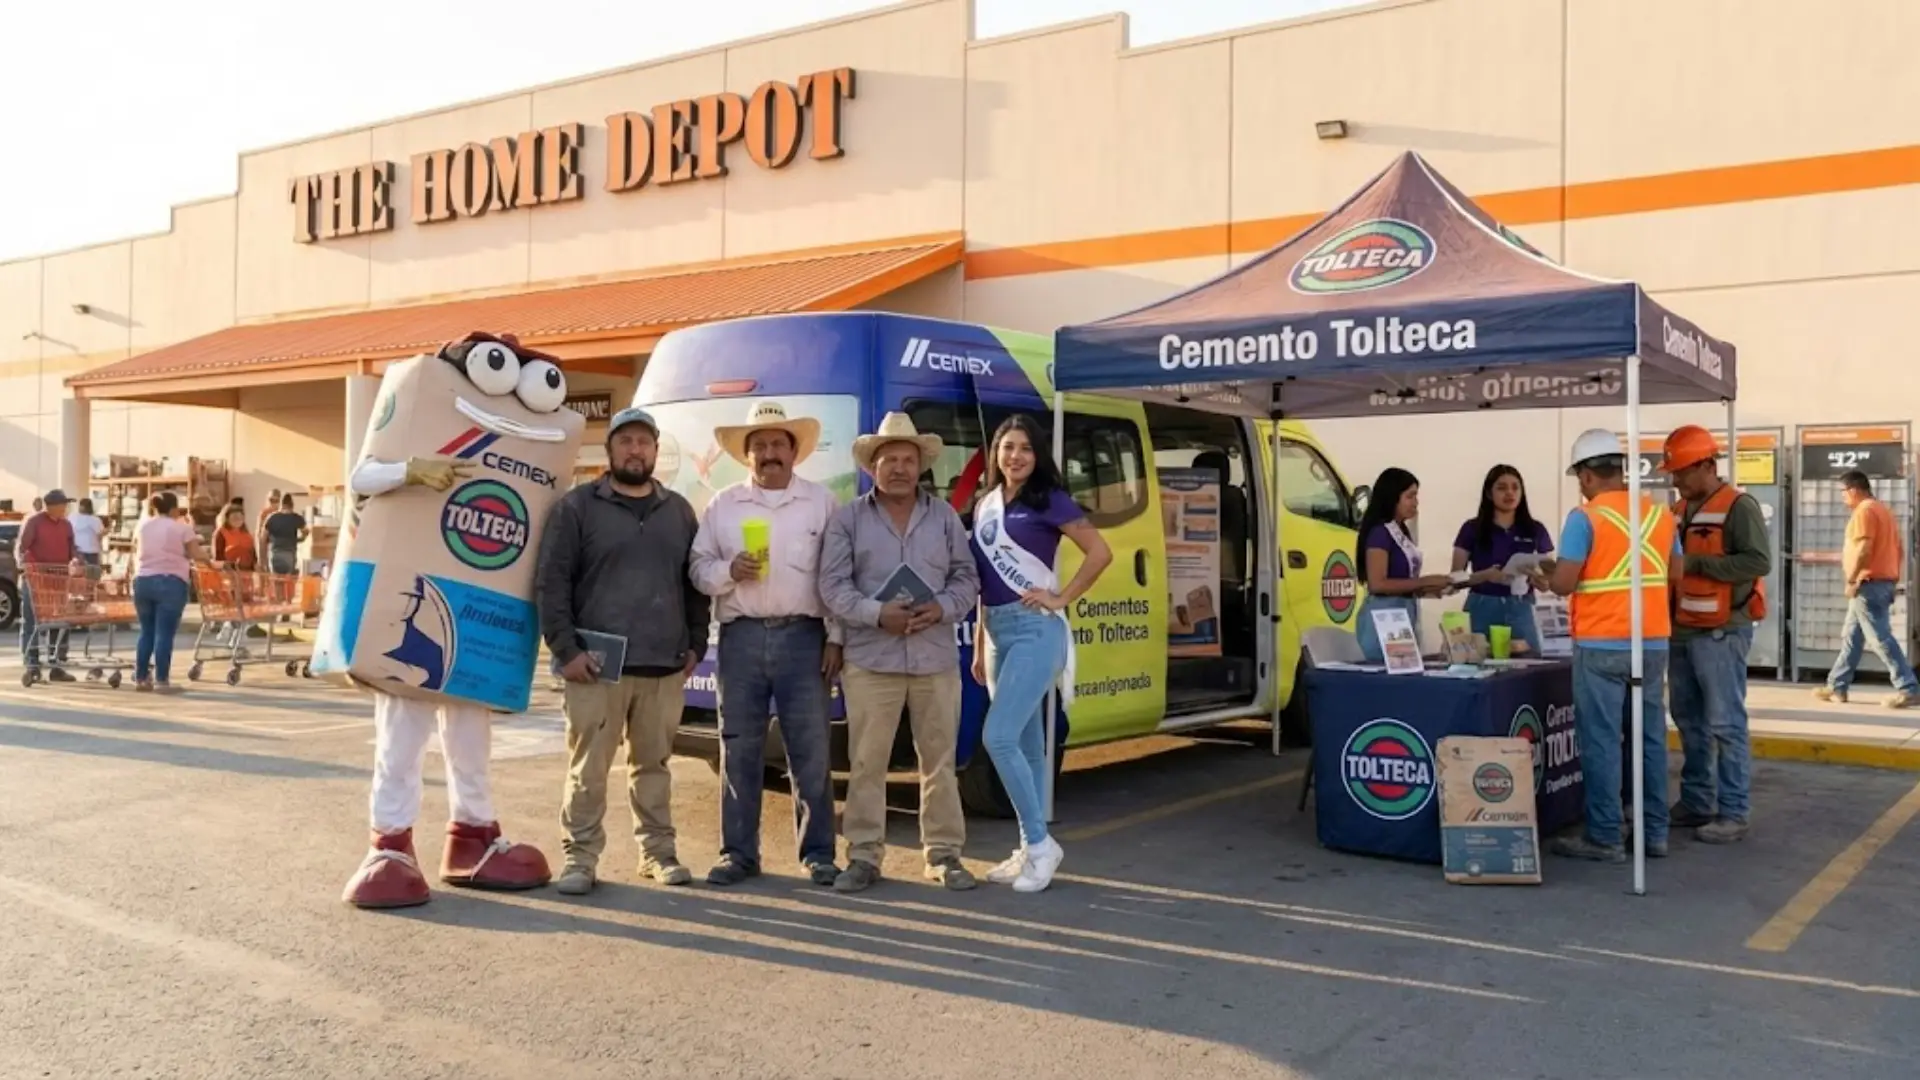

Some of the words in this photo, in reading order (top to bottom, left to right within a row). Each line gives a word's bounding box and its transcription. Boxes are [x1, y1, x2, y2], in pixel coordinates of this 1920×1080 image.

[288, 160, 396, 243] THE
[410, 122, 584, 224] HOME
[603, 66, 856, 193] DEPOT
[1300, 248, 1423, 277] TOLTECA
[1159, 325, 1318, 370] Cemento
[1330, 317, 1476, 358] Tolteca
[927, 352, 994, 377] CEMEX
[481, 451, 558, 490] CEMEX
[446, 503, 526, 547] TOLTECA
[1076, 596, 1149, 618] Cementos
[1546, 728, 1581, 769] TOLT
[1346, 754, 1430, 785] TOLTECA
